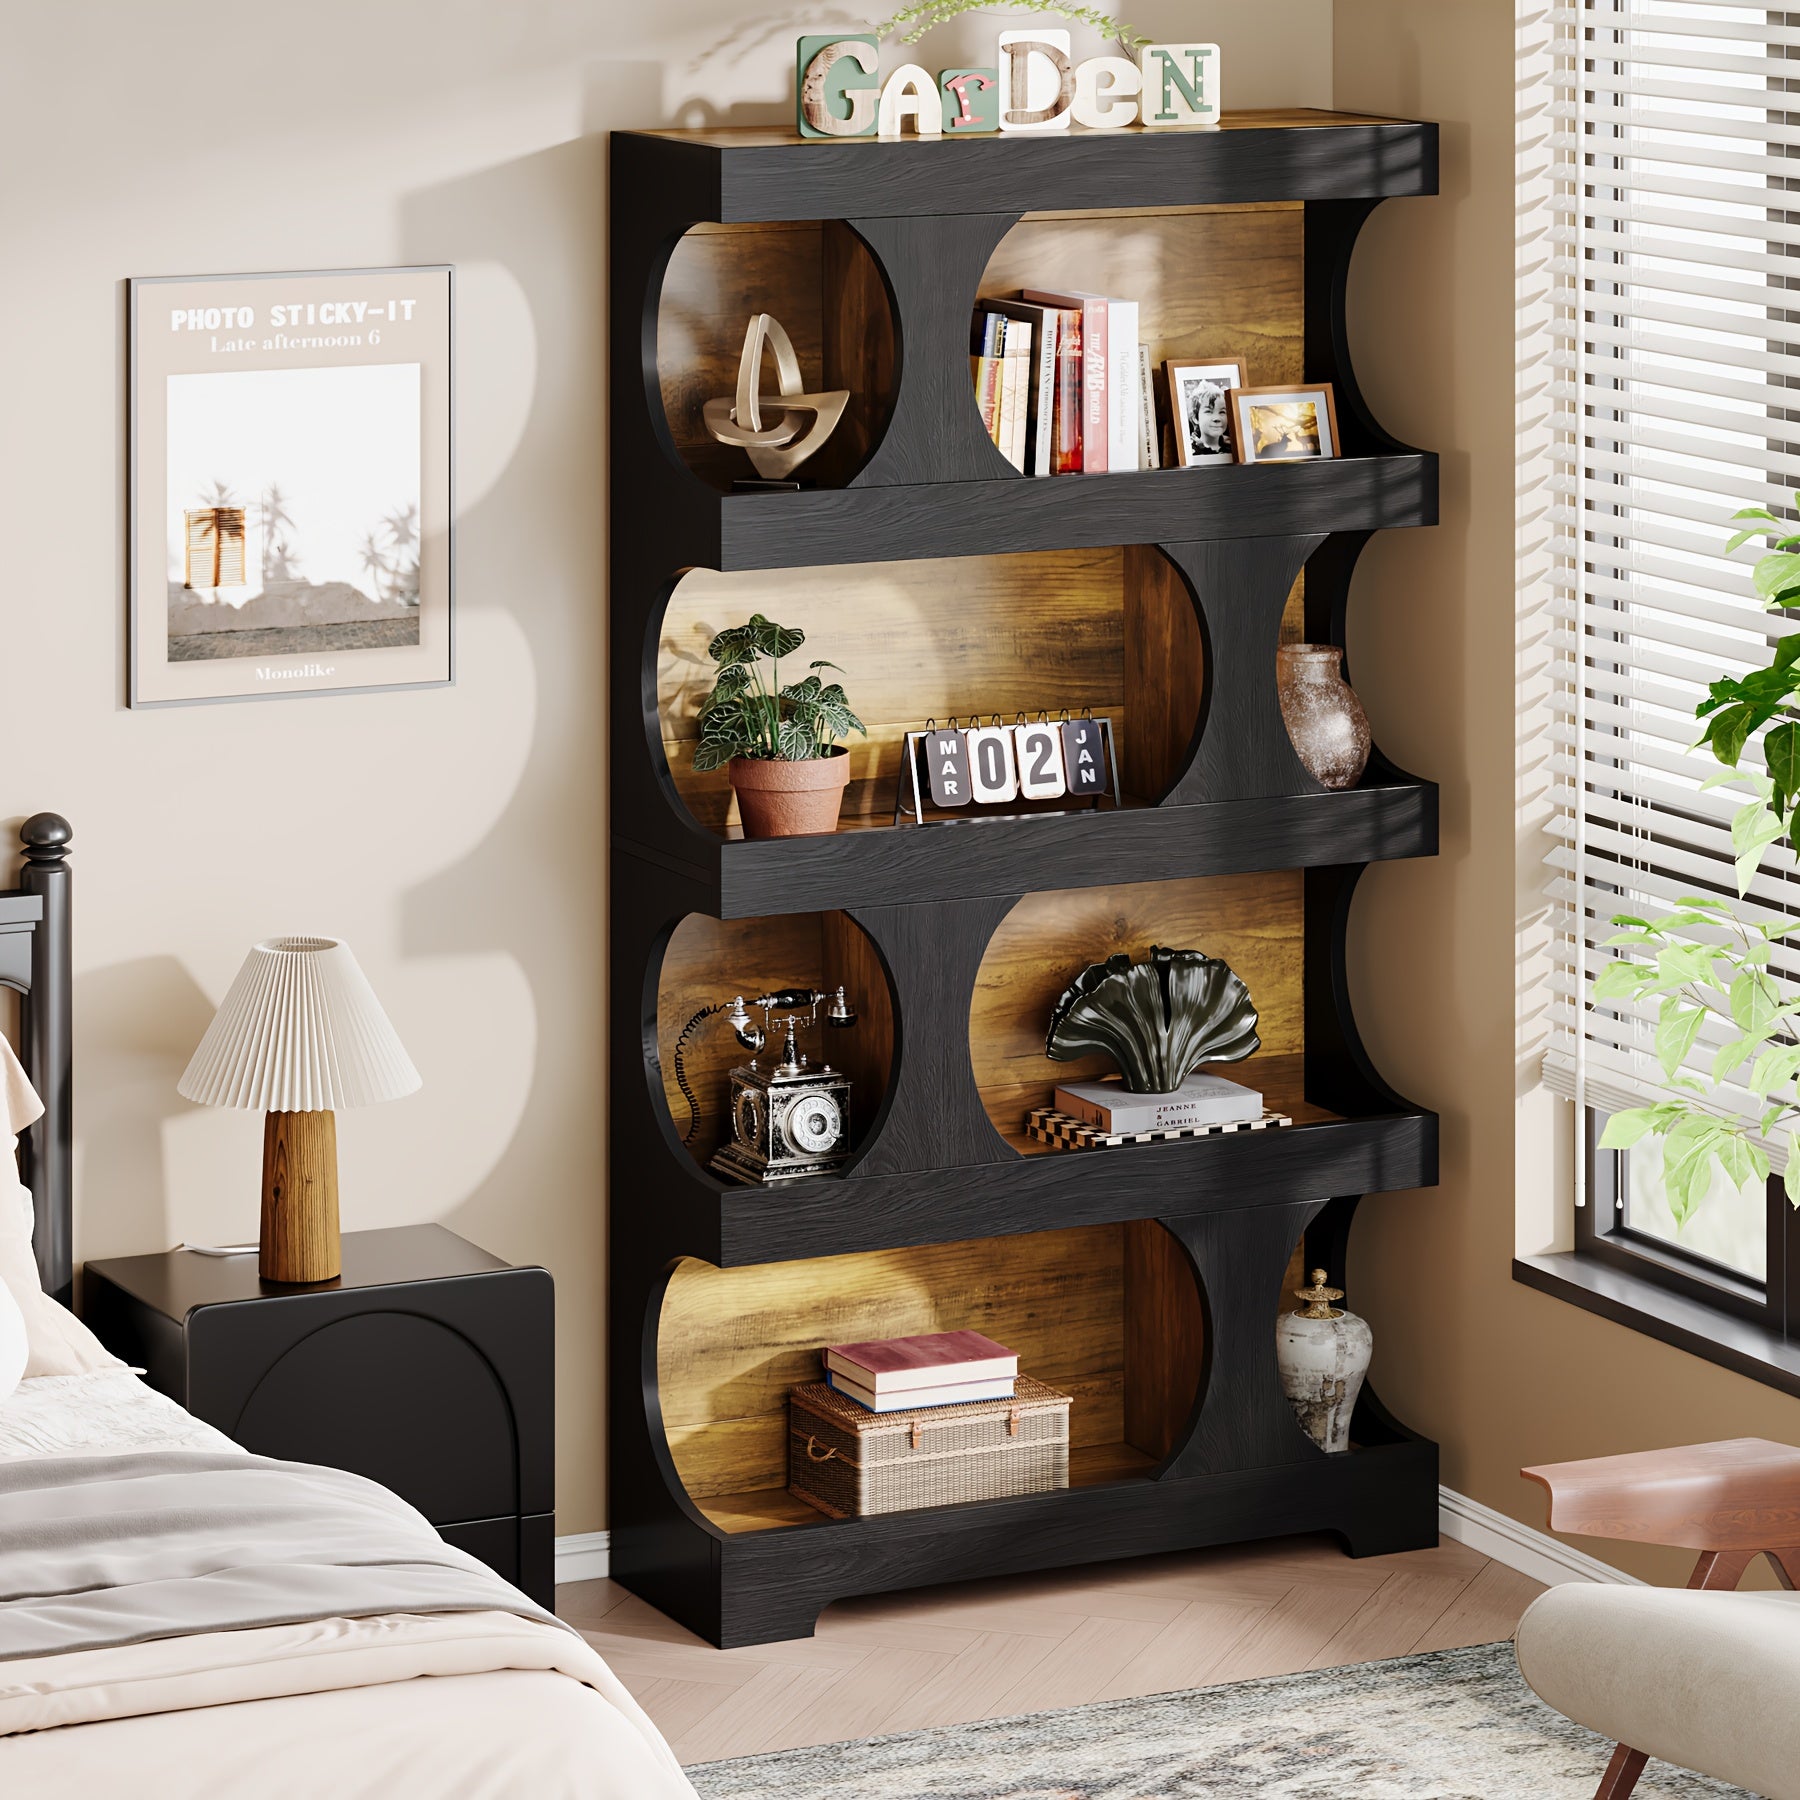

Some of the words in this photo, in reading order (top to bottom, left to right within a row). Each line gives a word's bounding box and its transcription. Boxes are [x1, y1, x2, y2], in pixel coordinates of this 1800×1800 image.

[171, 305, 255, 331] PHOTO
[269, 299, 417, 328] STICKY-IT
[210, 335, 257, 353] Late
[262, 331, 362, 351] afternoon
[368, 329, 381, 346] 6
[1044, 351, 1053, 385] DYLAN
[1087, 349, 1105, 391] ARAB
[1090, 390, 1101, 424] WORLD
[255, 663, 336, 682] Monolike
[939, 740, 959, 795] MAR
[1075, 729, 1096, 784] JAN
[1156, 1103, 1197, 1113] JEANNE
[1156, 1117, 1200, 1127] GABRIEL
